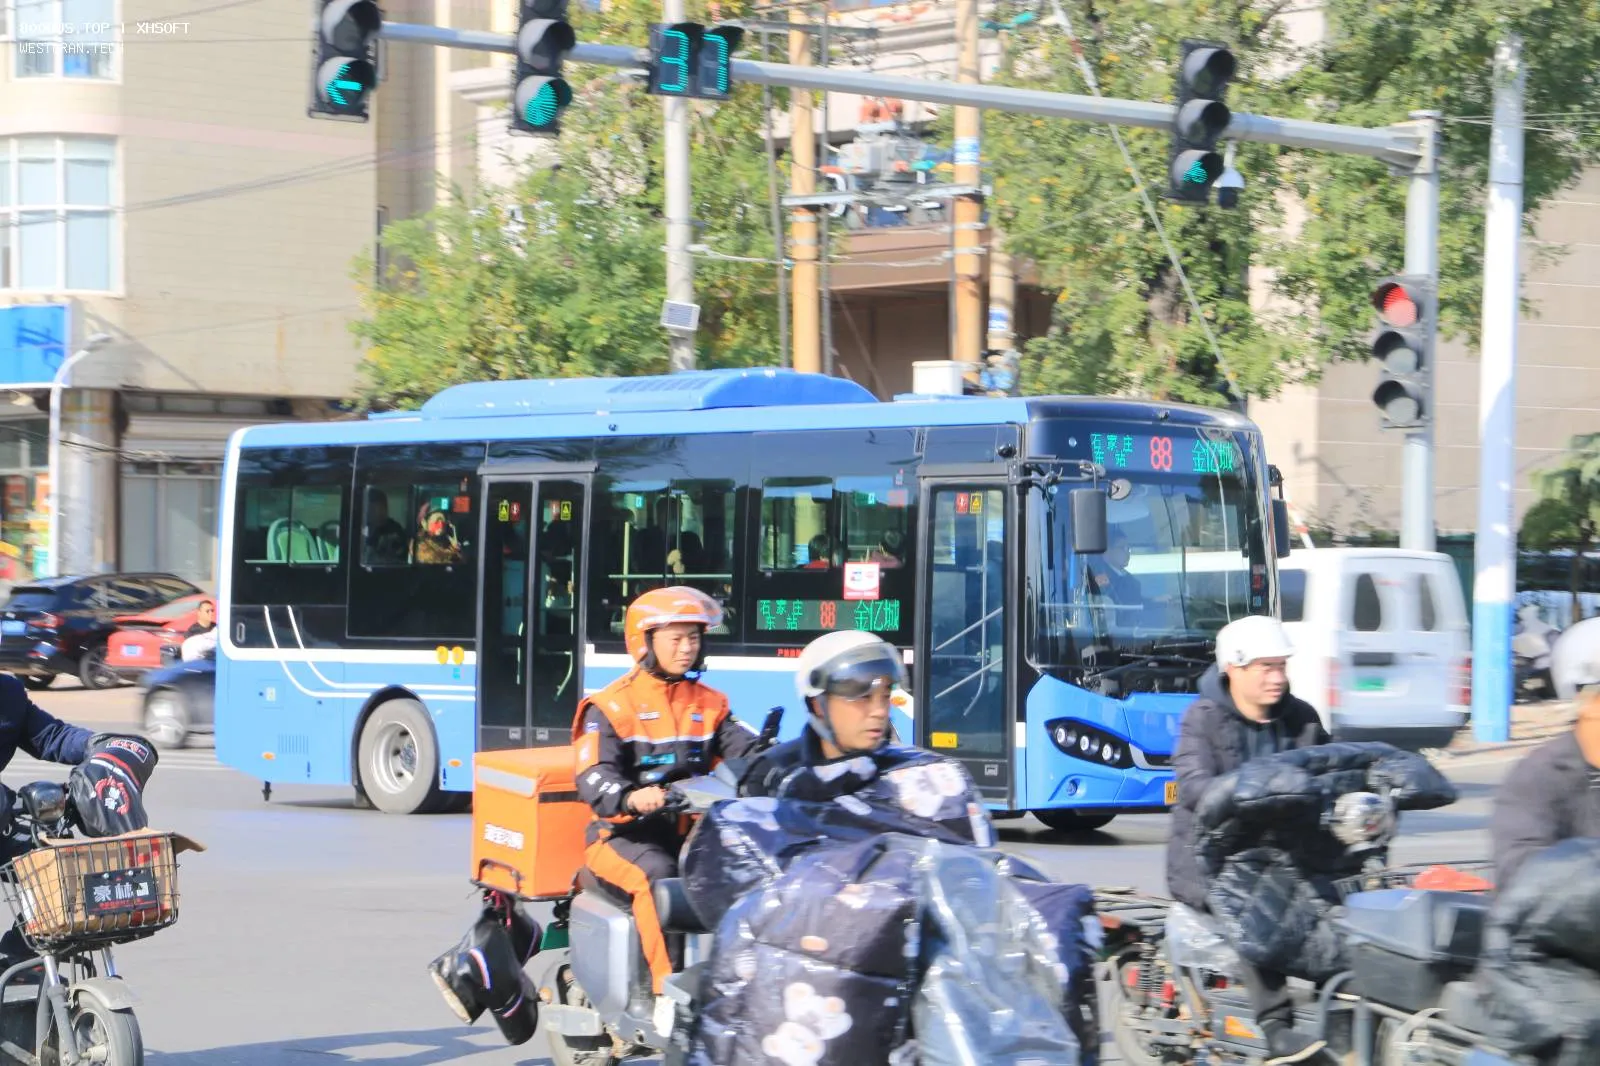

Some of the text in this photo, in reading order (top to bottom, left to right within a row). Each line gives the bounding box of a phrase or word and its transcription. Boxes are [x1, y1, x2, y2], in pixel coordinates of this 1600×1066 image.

[660, 28, 729, 93] 37
[1150, 436, 1172, 471] 88
[820, 601, 836, 629] 88
[854, 599, 900, 632] 金亿城
